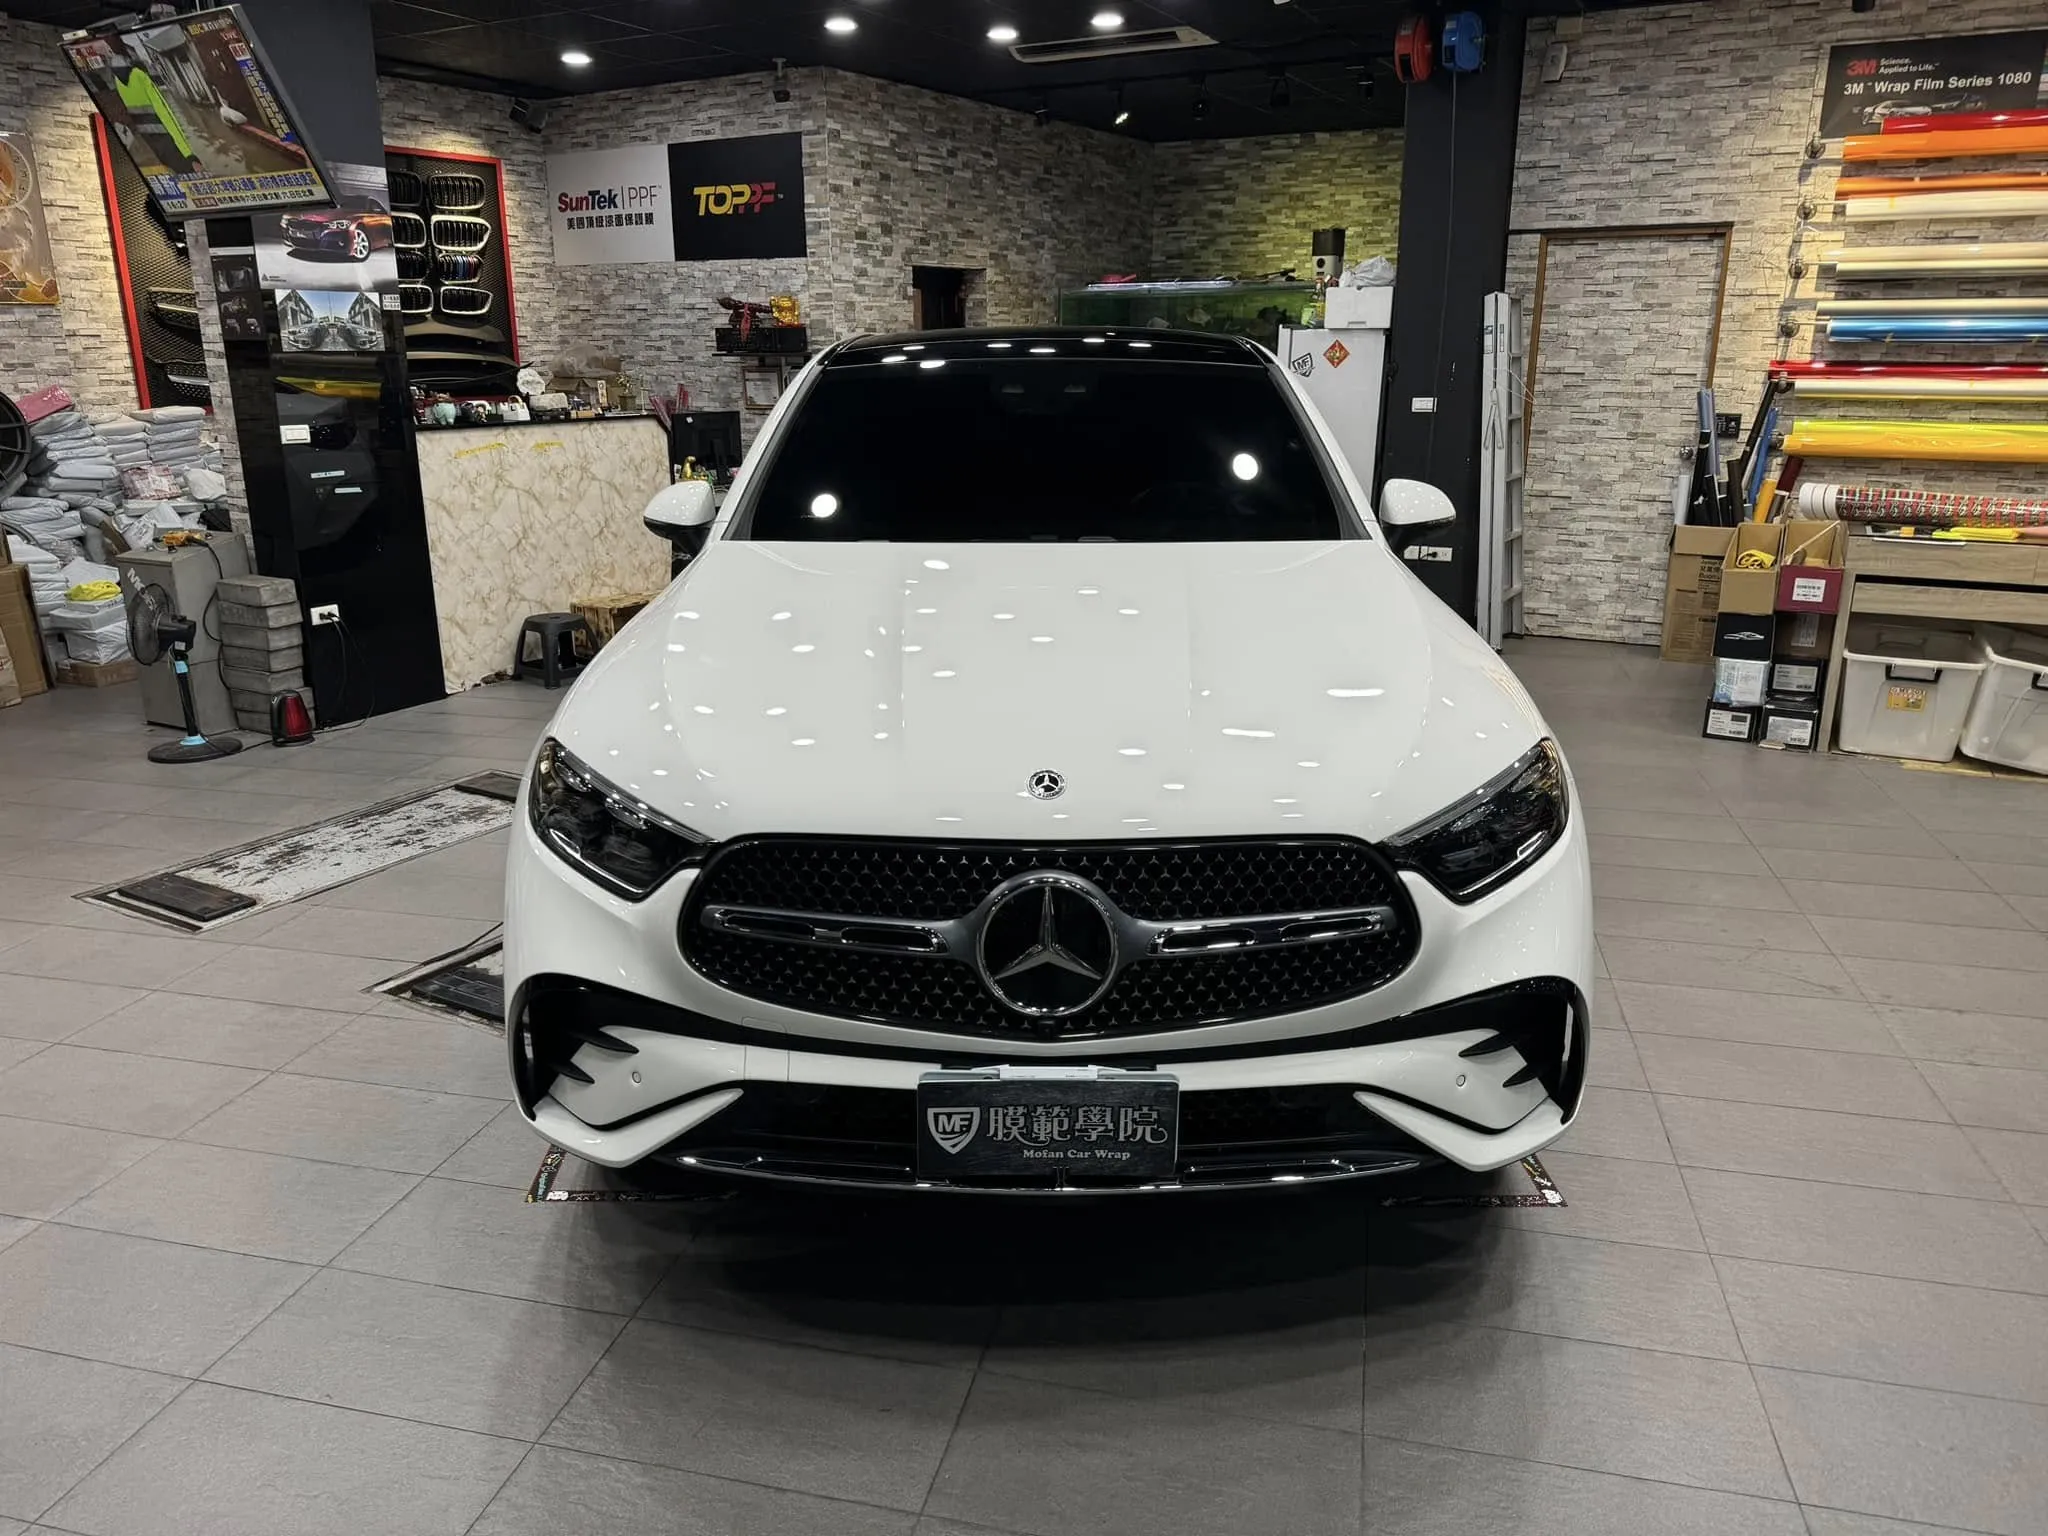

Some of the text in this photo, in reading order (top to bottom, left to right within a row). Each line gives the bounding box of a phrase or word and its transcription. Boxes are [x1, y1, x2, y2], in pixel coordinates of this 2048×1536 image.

[1847, 59, 1876, 76] 3M
[1878, 65, 1908, 75] Applied
[1880, 57, 1912, 66] Science.
[1843, 71, 2033, 96] 3M Wrap Film Series 1080
[558, 185, 658, 213] SunTek PPF
[693, 181, 776, 216] TOPPF
[937, 1114, 971, 1133] MF
[986, 1105, 1168, 1147] 膜範學院
[1023, 1149, 1131, 1161] Mofan Car Wrap
